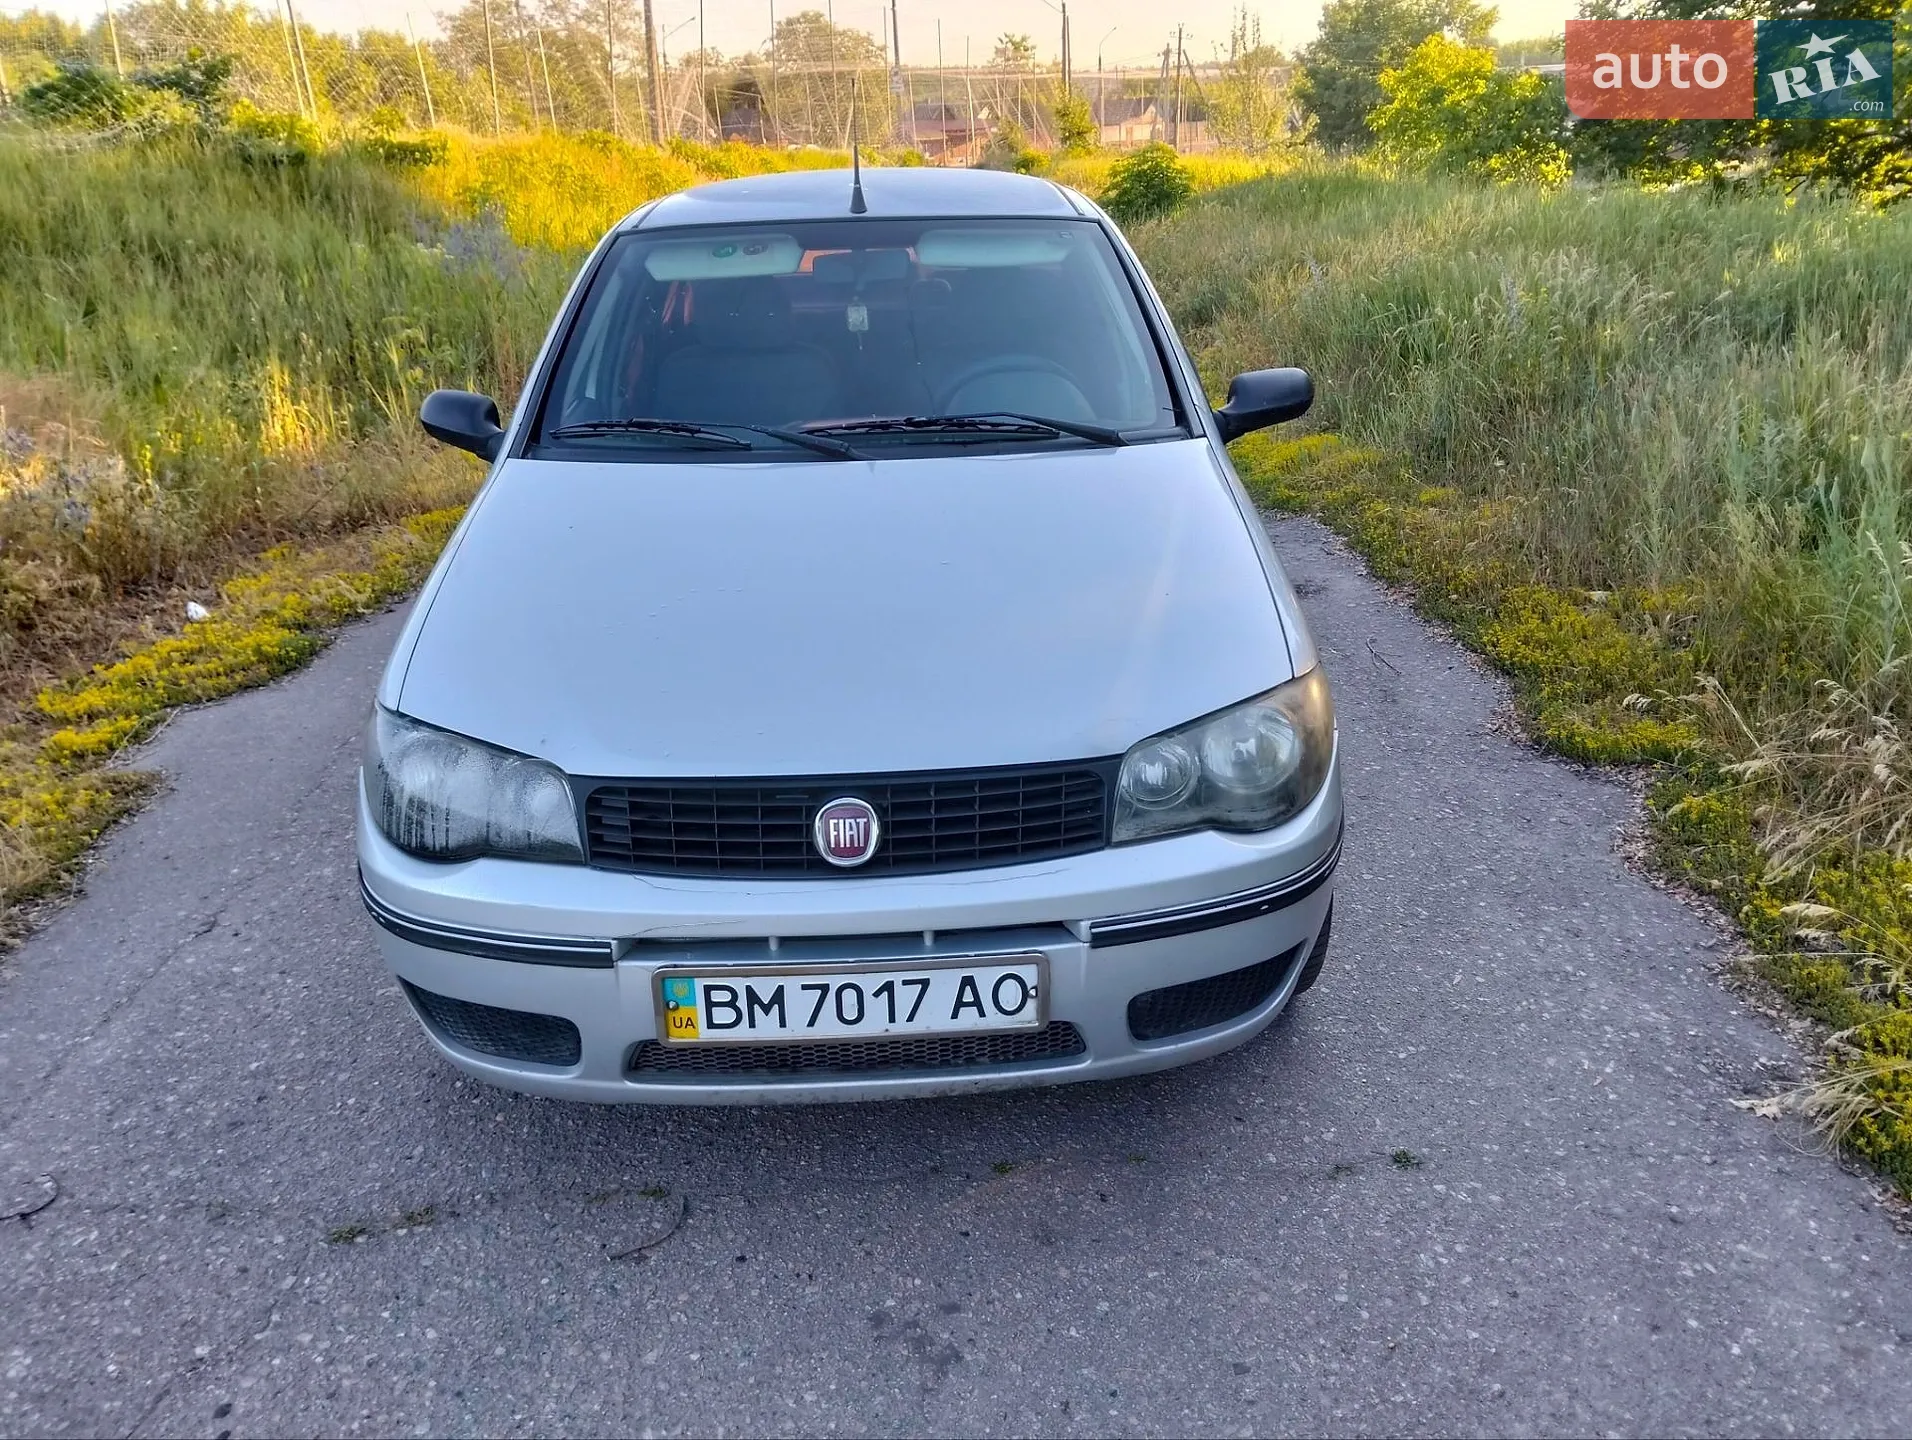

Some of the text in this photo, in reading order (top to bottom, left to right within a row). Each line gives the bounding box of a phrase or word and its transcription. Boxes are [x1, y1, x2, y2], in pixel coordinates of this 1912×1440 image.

[829, 818, 867, 848] FIAT
[703, 972, 1028, 1029] BM 7017 AO
[673, 1016, 695, 1029] UA
